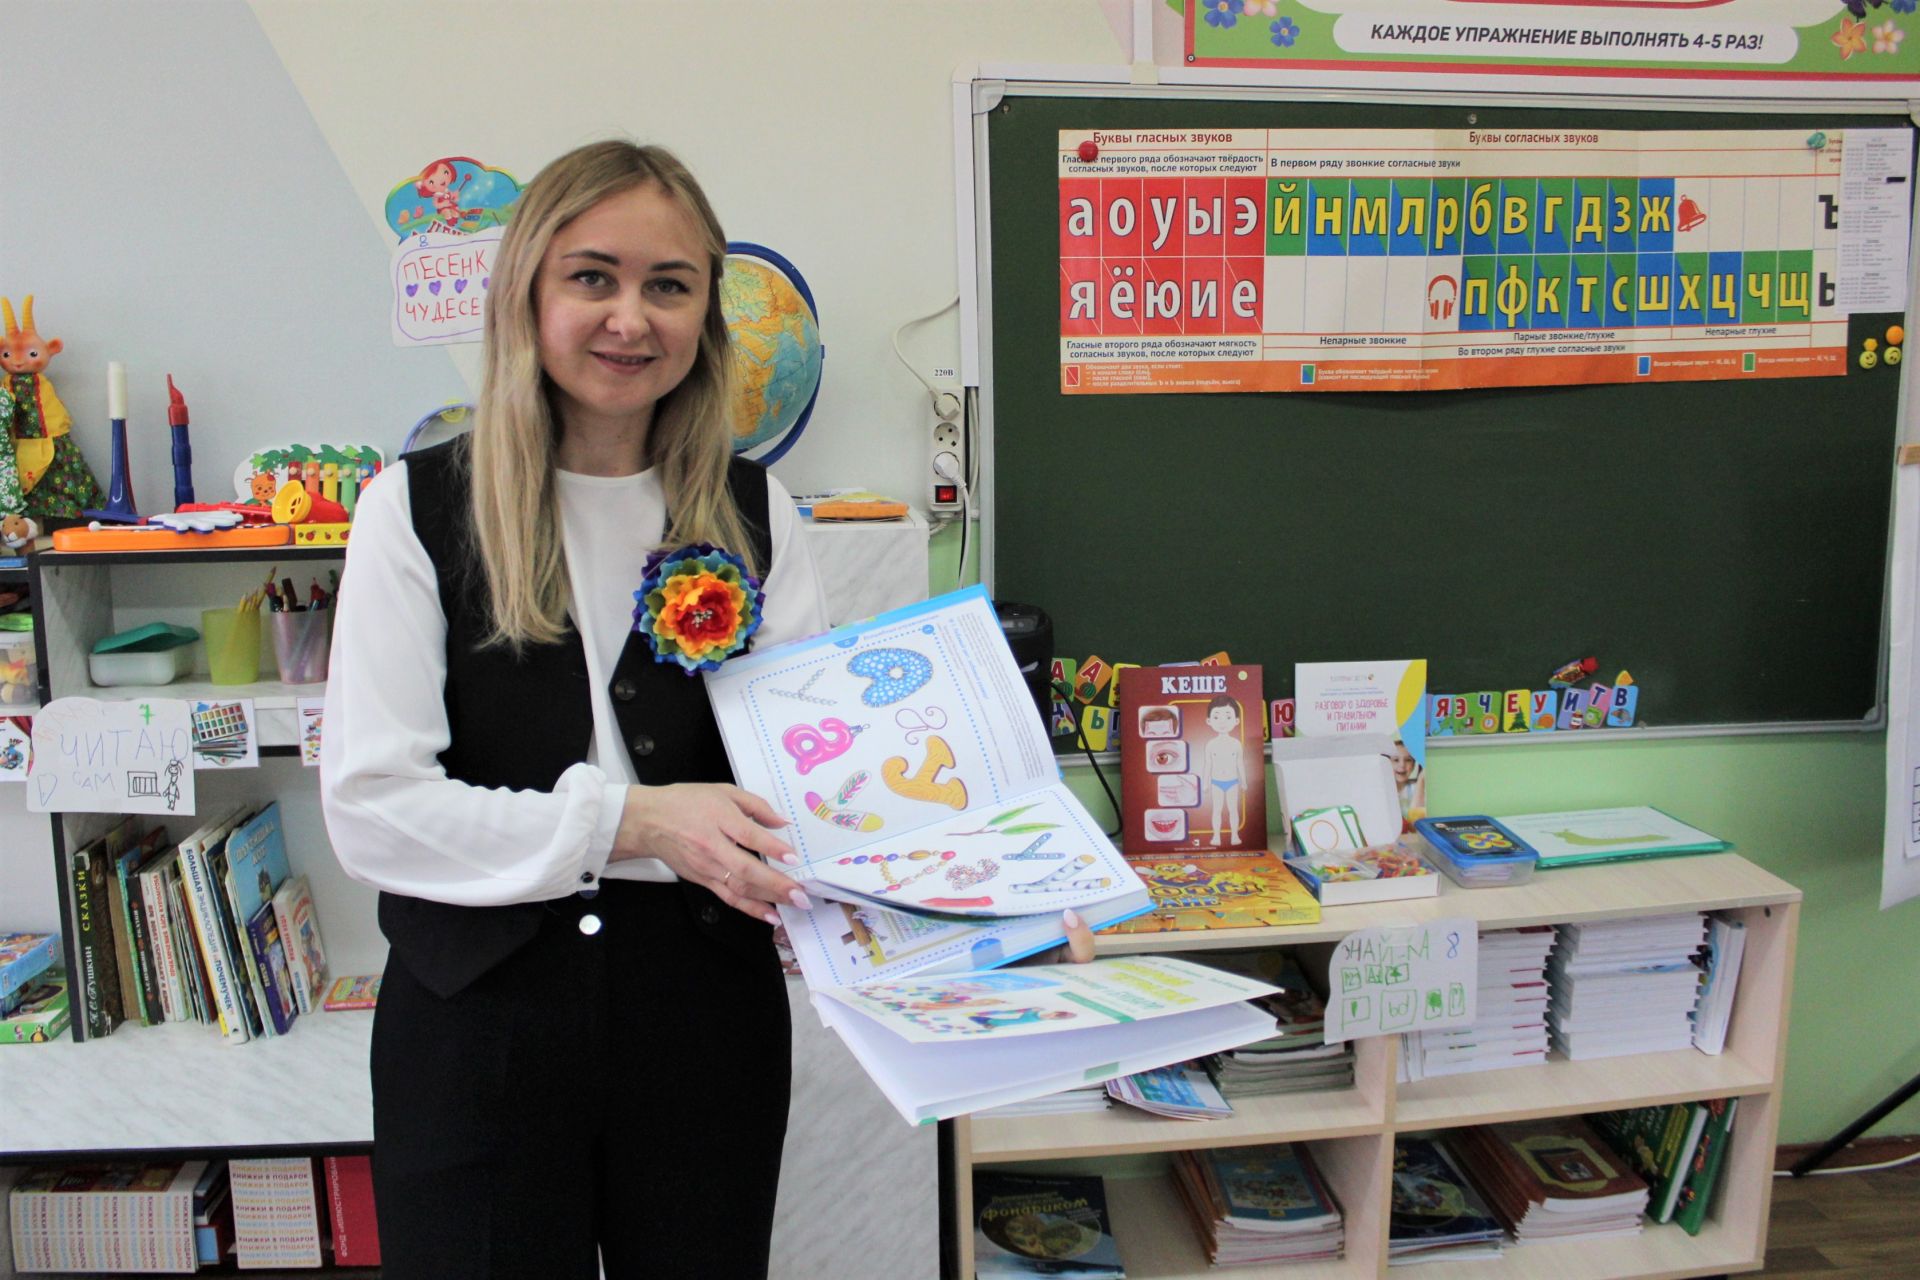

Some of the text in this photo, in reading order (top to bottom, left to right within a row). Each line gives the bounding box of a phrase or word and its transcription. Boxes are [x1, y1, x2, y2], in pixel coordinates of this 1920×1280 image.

[1370, 24, 1764, 50] КАЖДОЕ УПРАЖНЕНИЕ ВЫПОЛНЯТЬ 4-5 РАЗ!
[1093, 132, 1233, 145] Буквы гласных звуков
[1469, 131, 1599, 145] Буквы согласных звуков
[1100, 156, 1136, 165] первого
[1139, 156, 1161, 165] ряда
[1163, 155, 1216, 163] обозначают
[1218, 154, 1264, 164] твёрдость
[1271, 158, 1461, 170] В первом ряду звонкие согласные звуки
[1068, 165, 1114, 173] согласных
[1116, 165, 1149, 174] звуков,
[1179, 164, 1217, 173] которых
[1219, 164, 1257, 174] следуют
[1514, 331, 1616, 343] Парные звонкие/глухие
[1705, 326, 1777, 337] Непарные глухие
[1066, 340, 1257, 350] Гласные второго ряда обозначают мягкость
[1320, 336, 1366, 346] Непарные
[1070, 350, 1114, 358] согласных
[1117, 350, 1149, 359] звуков,
[1178, 349, 1215, 358] которых
[1217, 349, 1254, 359] следуют
[1458, 345, 1626, 356] Во втором ряду глухие согласные звуки
[934, 369, 954, 377] 220В
[1161, 675, 1227, 695] КЕШЕ
[60, 728, 189, 767] ЧИТАЮ
[186, 849, 203, 893] БОЛЬШАЯ
[76, 871, 92, 932] СКАЗКИ
